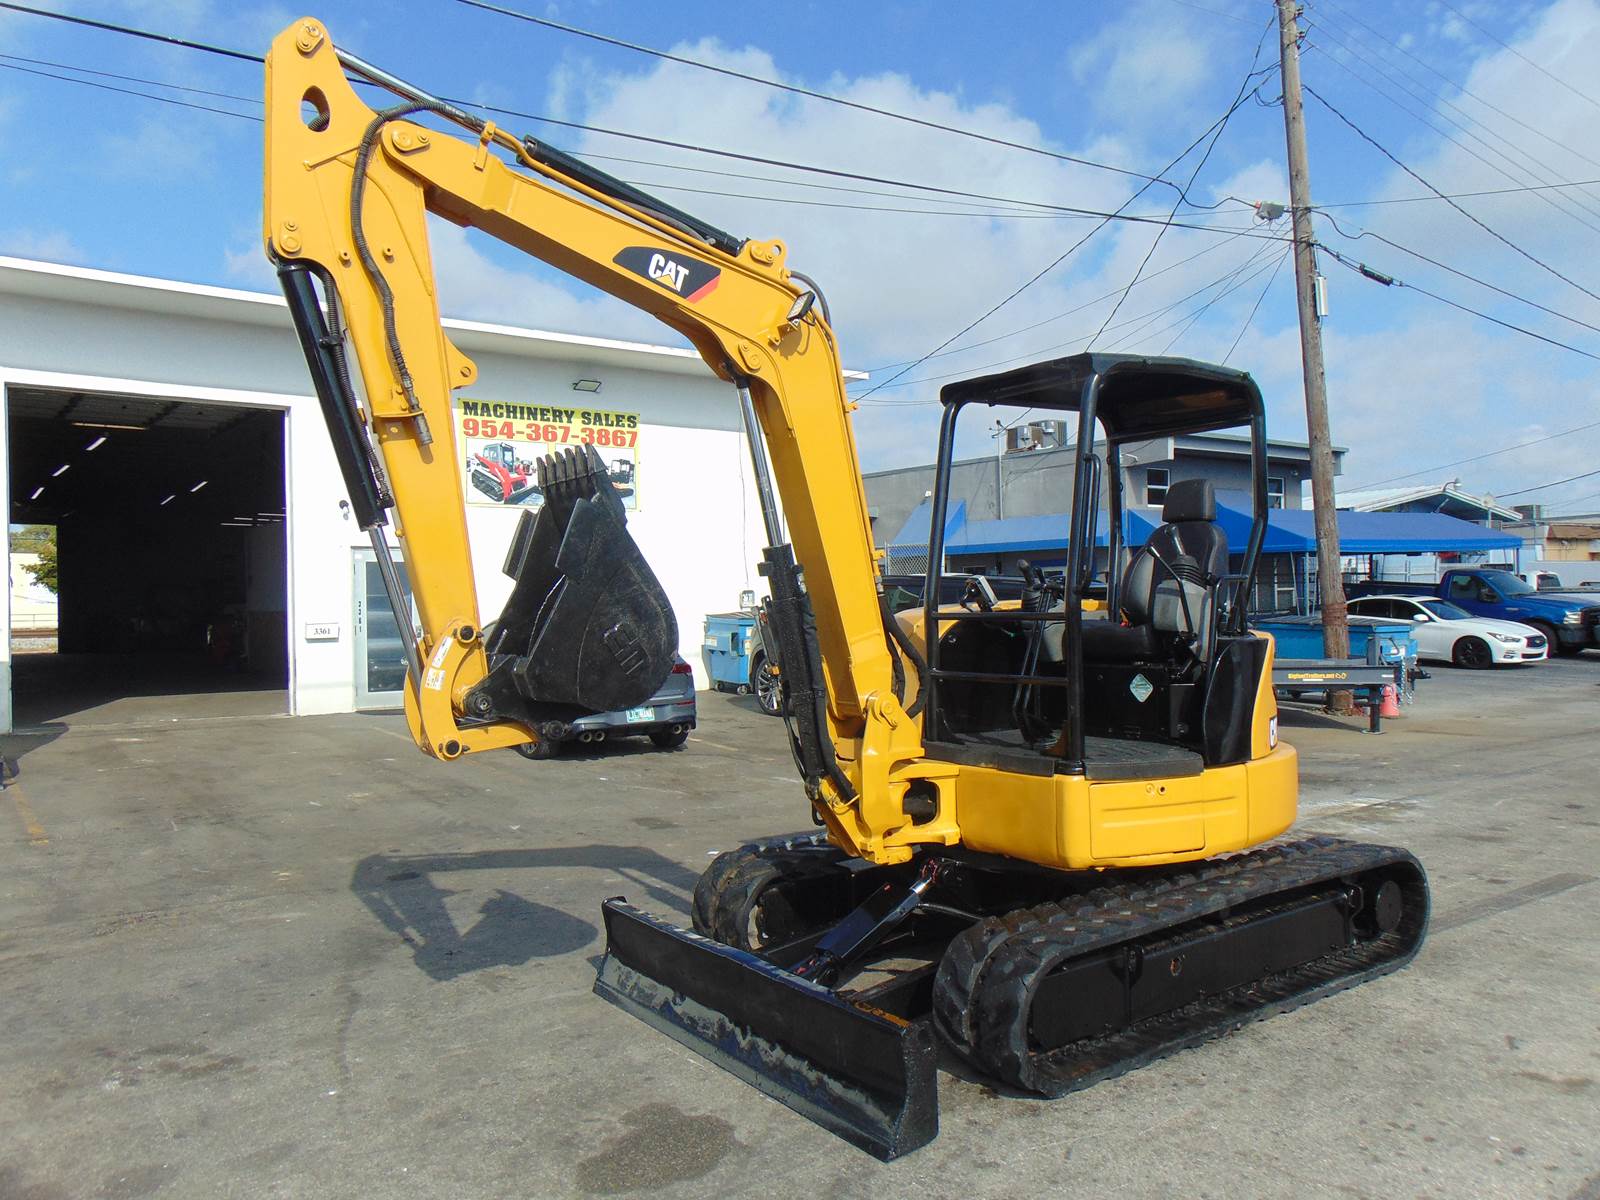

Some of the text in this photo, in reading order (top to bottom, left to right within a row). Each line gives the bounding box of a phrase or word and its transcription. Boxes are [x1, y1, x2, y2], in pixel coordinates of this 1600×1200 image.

[648, 253, 690, 292] CAT
[462, 401, 638, 428] MACHINERY SALES
[462, 418, 638, 448] 954-367-3867
[313, 627, 331, 636] 3361
